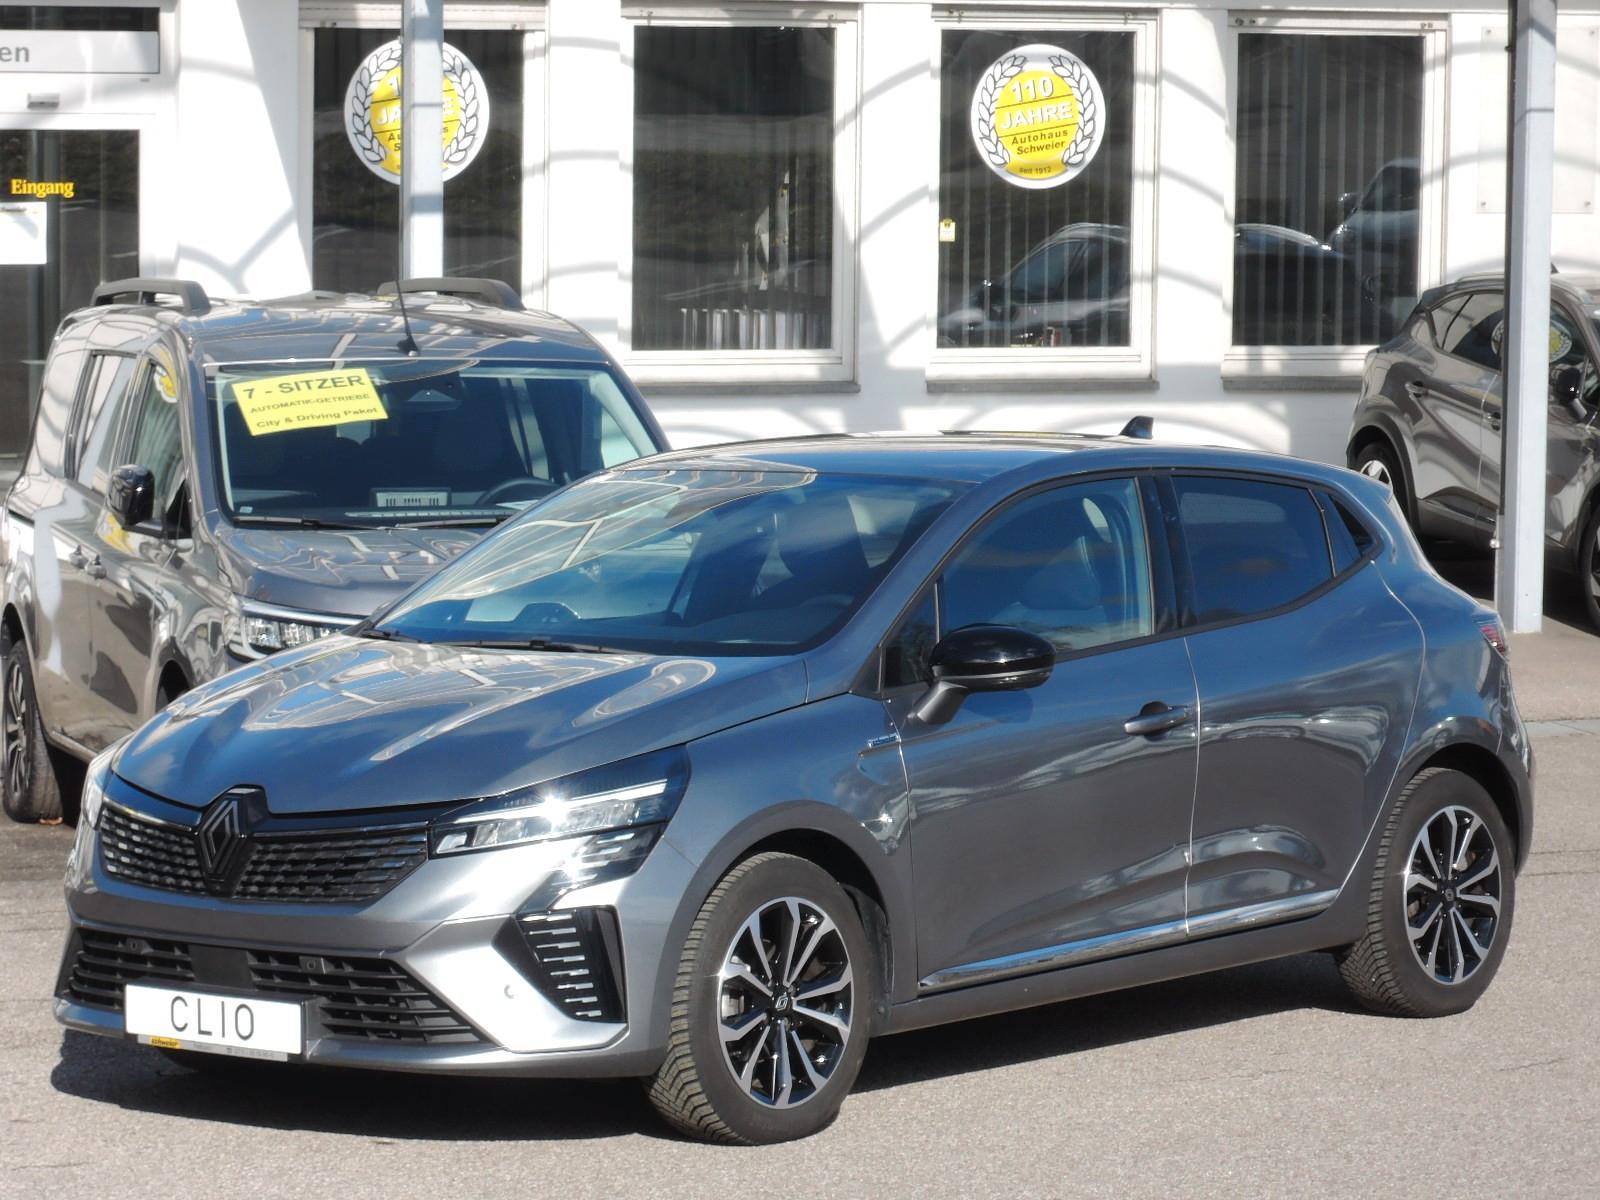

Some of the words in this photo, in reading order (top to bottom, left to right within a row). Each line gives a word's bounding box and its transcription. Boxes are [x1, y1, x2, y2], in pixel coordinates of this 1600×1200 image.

[1012, 77, 1054, 102] 110
[376, 97, 454, 126] JAE
[1000, 101, 1074, 129] JAHRE
[1011, 129, 1068, 145] Autohaus
[1016, 141, 1066, 155] Schweier
[11, 178, 75, 198] Eingang
[243, 388, 255, 400] 7
[278, 375, 366, 394] SITZER
[250, 393, 371, 414] AUTOMATIK-GETRIEBE
[256, 418, 281, 428] City
[284, 416, 294, 424] &
[296, 411, 341, 422] Driving
[170, 995, 255, 1041] CLIO
